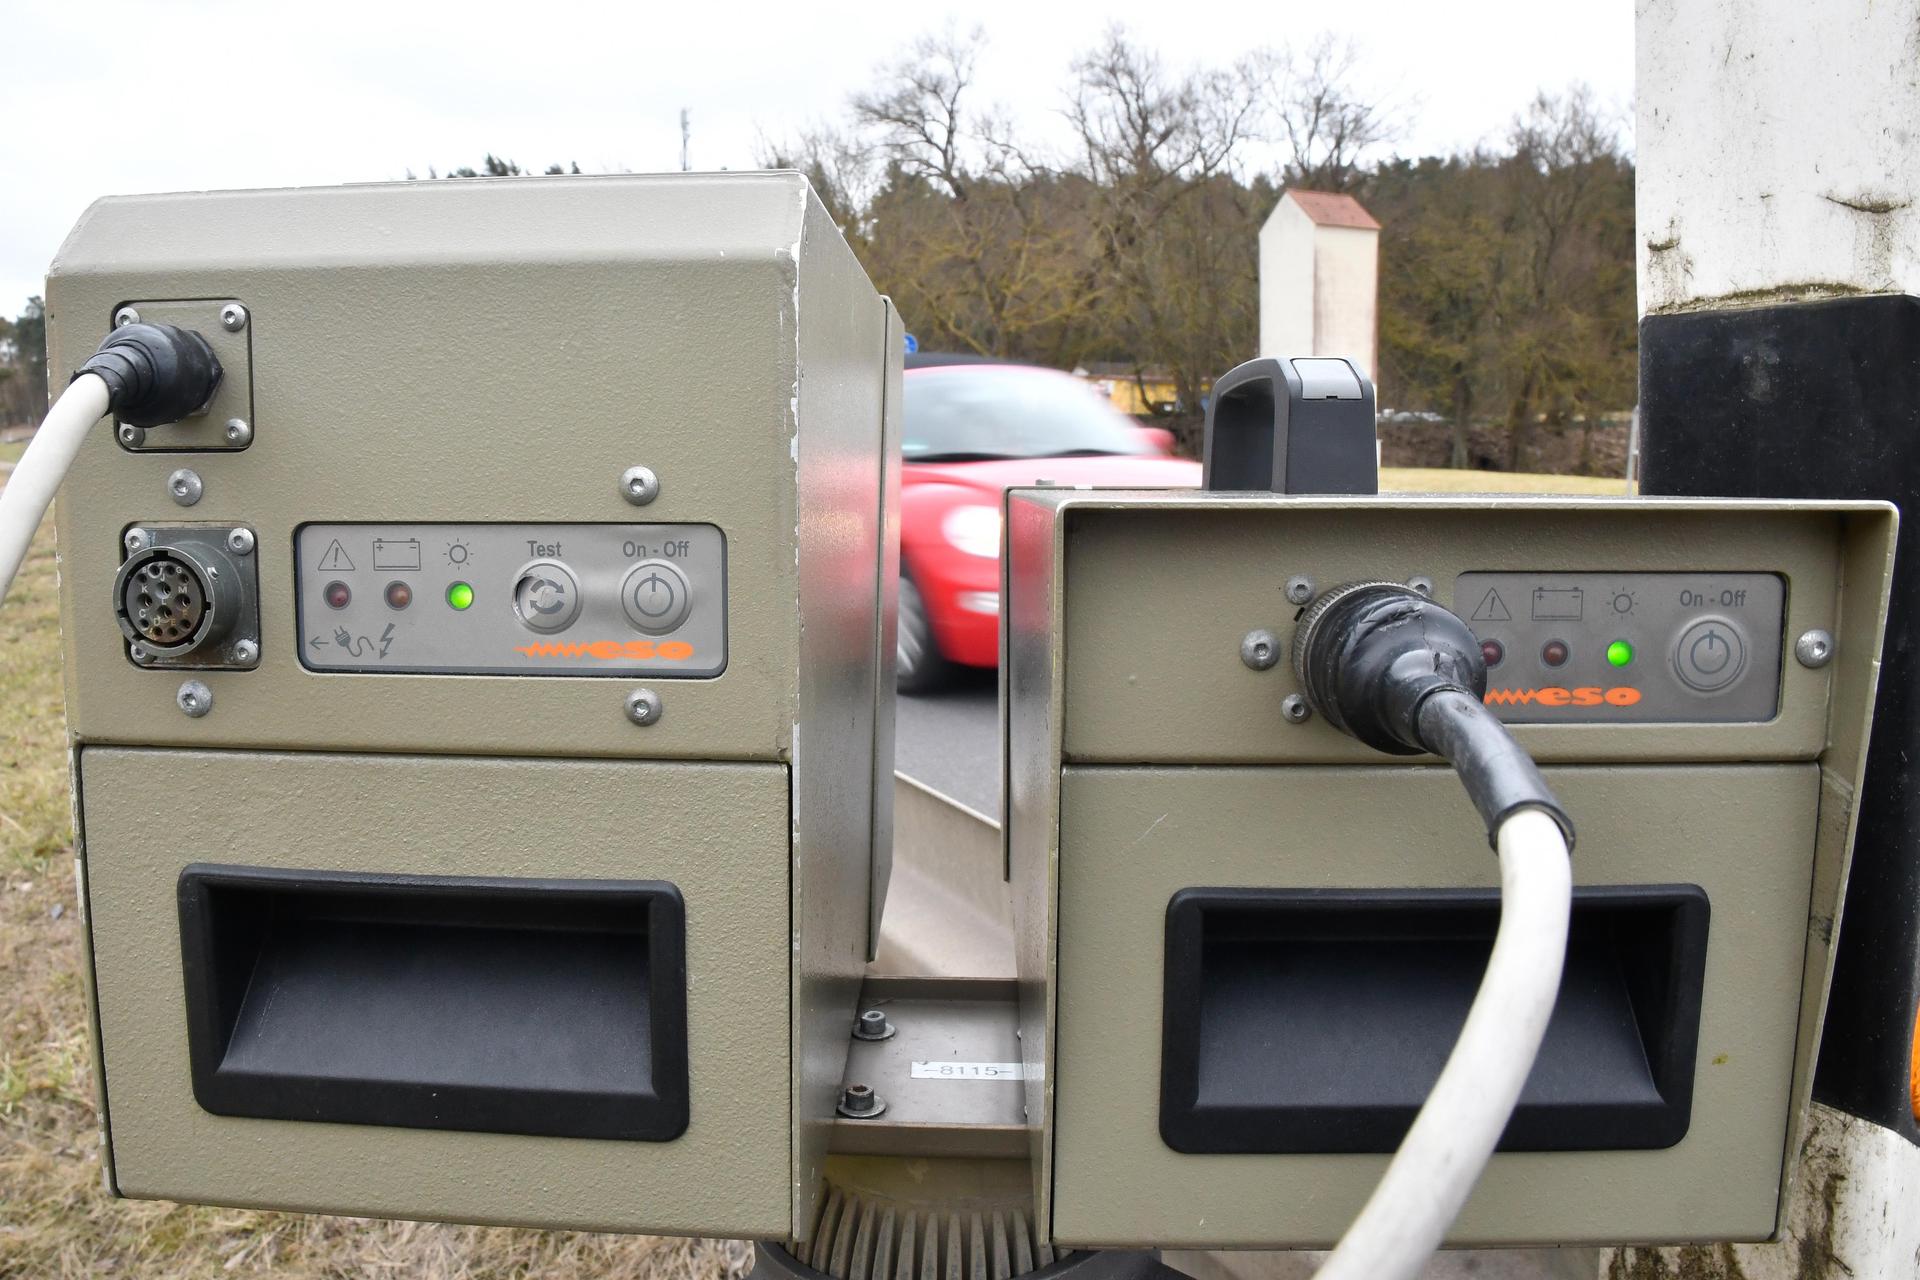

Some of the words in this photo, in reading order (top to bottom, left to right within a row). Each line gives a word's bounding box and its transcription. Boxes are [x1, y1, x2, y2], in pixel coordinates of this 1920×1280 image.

[527, 540, 562, 557] Test
[622, 541, 647, 557] On
[663, 540, 690, 557] Off
[1680, 590, 1703, 606] On
[1720, 590, 1746, 606] Off
[139, 609, 146, 617] C
[589, 641, 693, 660] eso
[1535, 687, 1642, 706] eso
